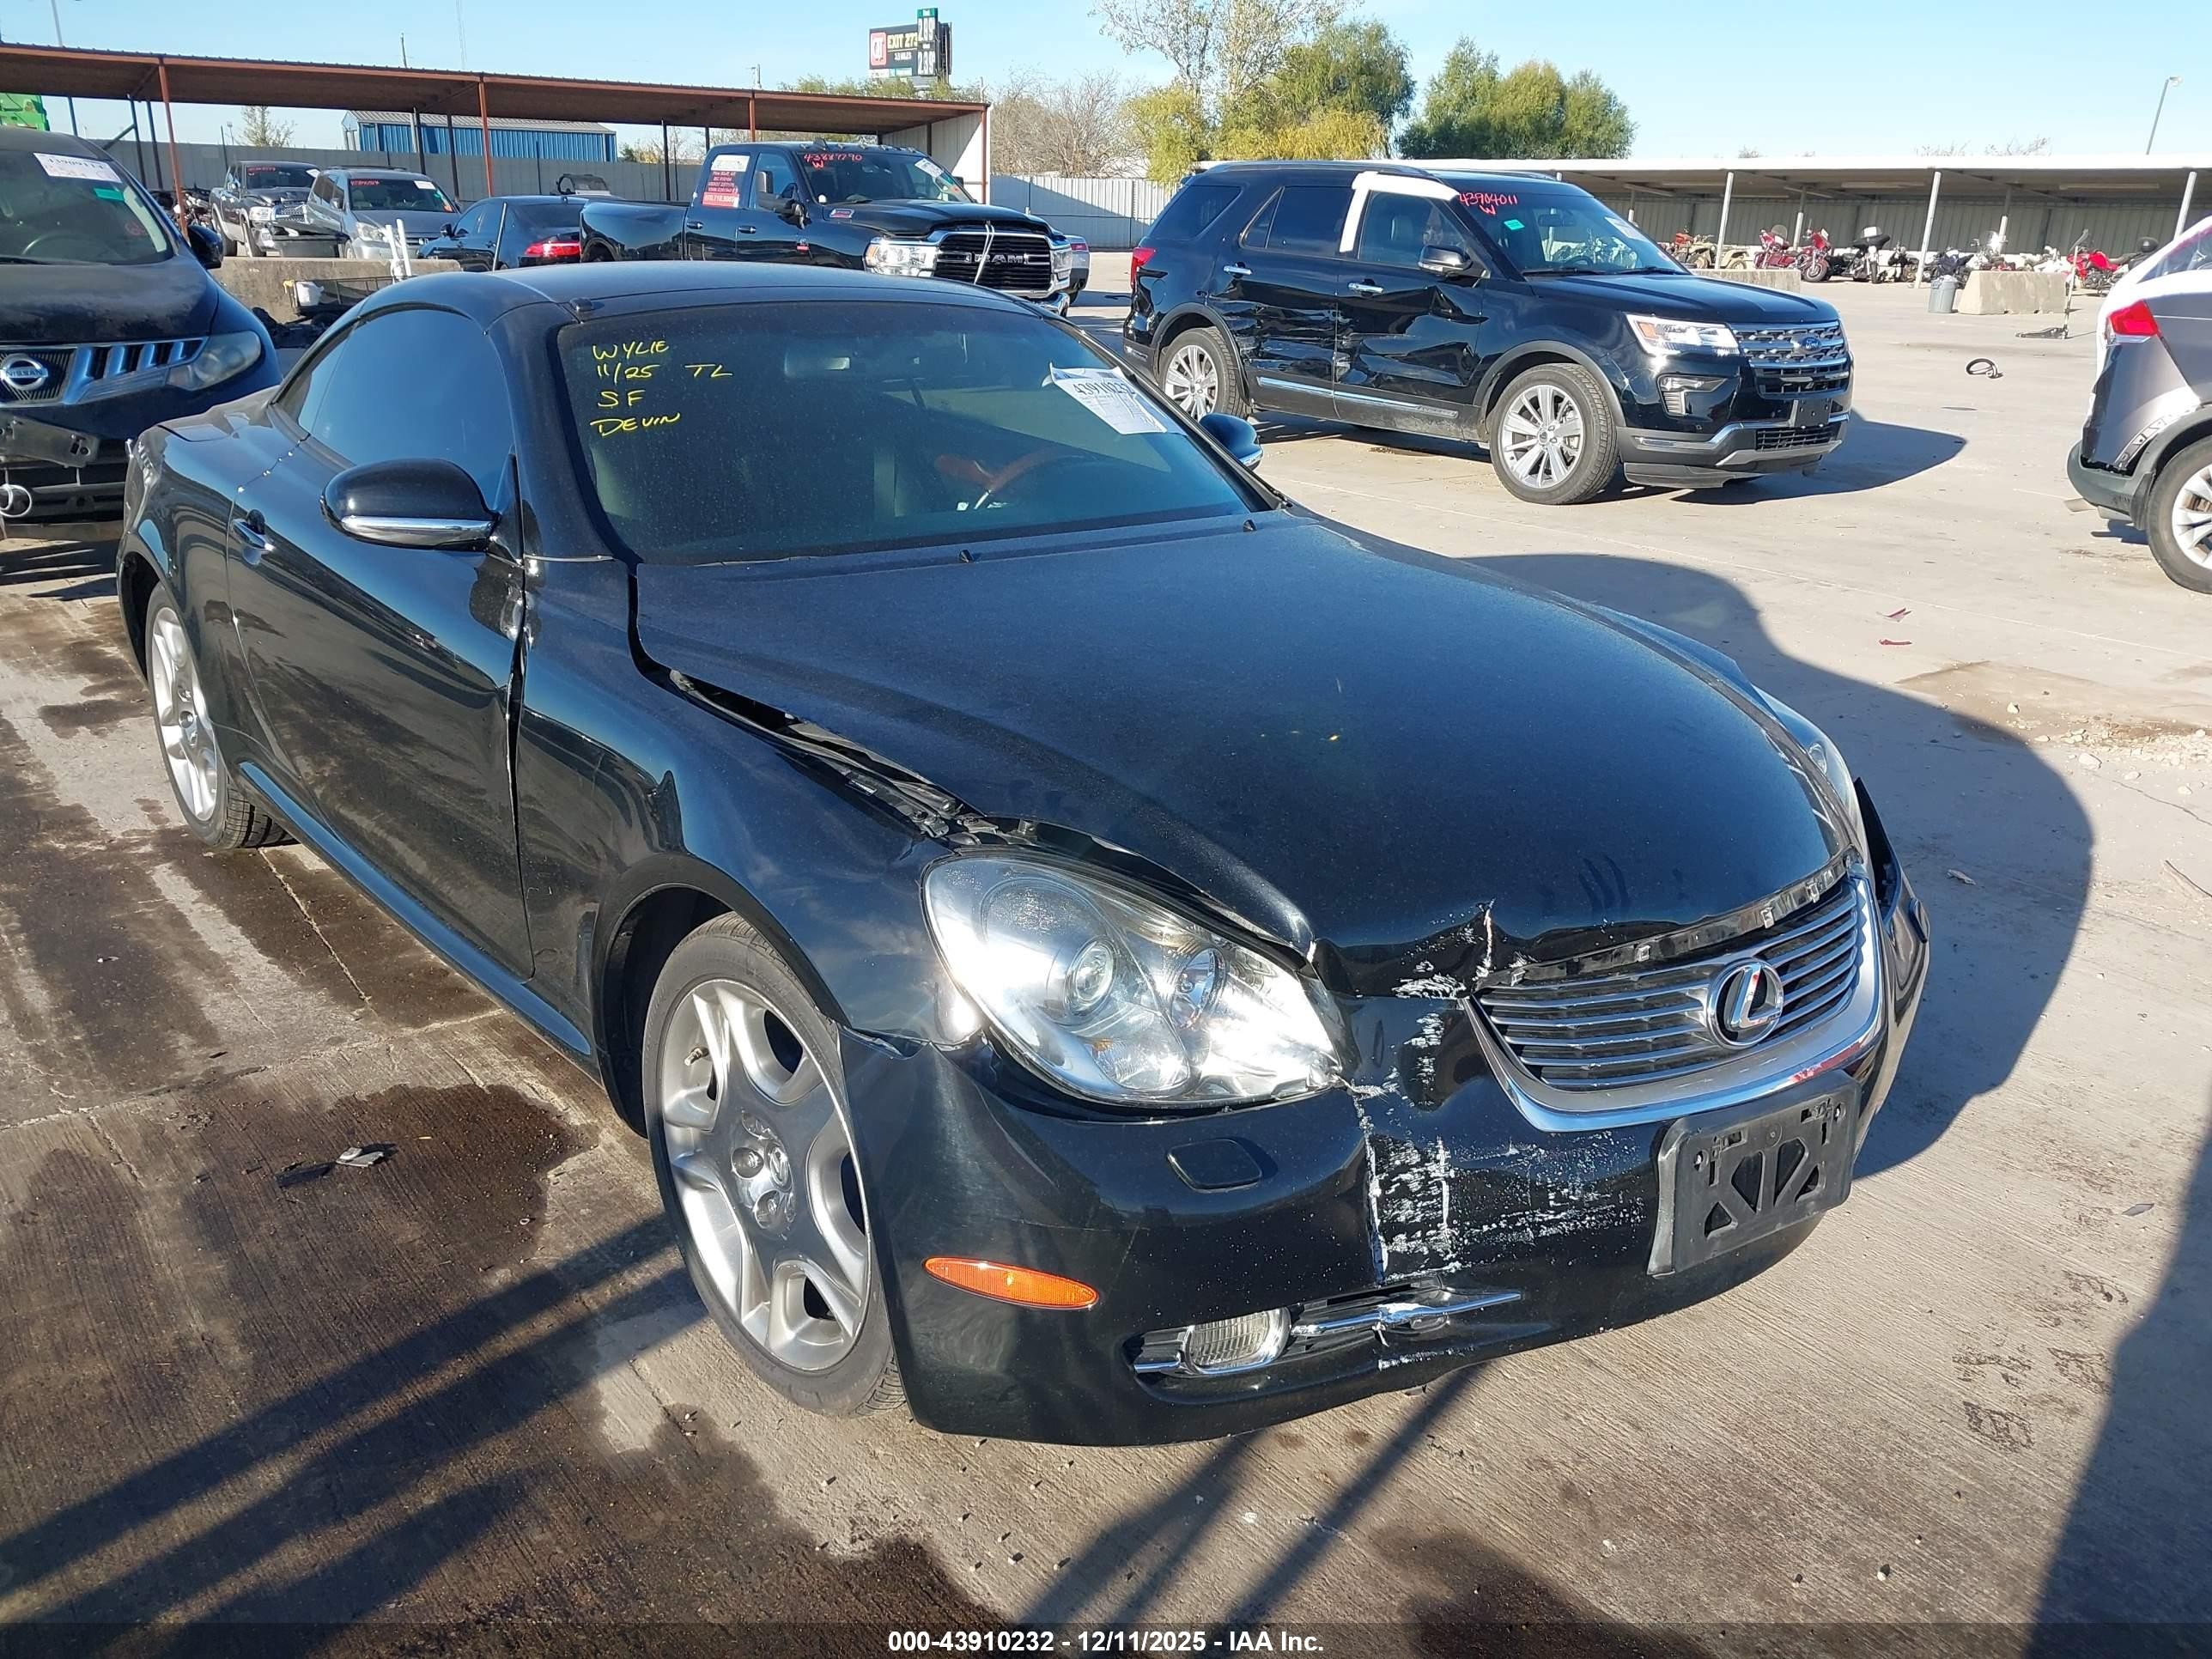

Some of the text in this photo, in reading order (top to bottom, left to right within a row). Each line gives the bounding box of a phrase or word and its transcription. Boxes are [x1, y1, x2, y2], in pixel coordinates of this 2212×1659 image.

[887, 33, 904, 49] EXIT
[1460, 191, 1518, 206] 43904011
[974, 252, 1024, 264] RAM
[592, 340, 670, 360] WYLIE
[6, 369, 44, 378] NISSAN
[597, 362, 733, 385] 11/25 TL
[589, 412, 681, 437] DEVIN
